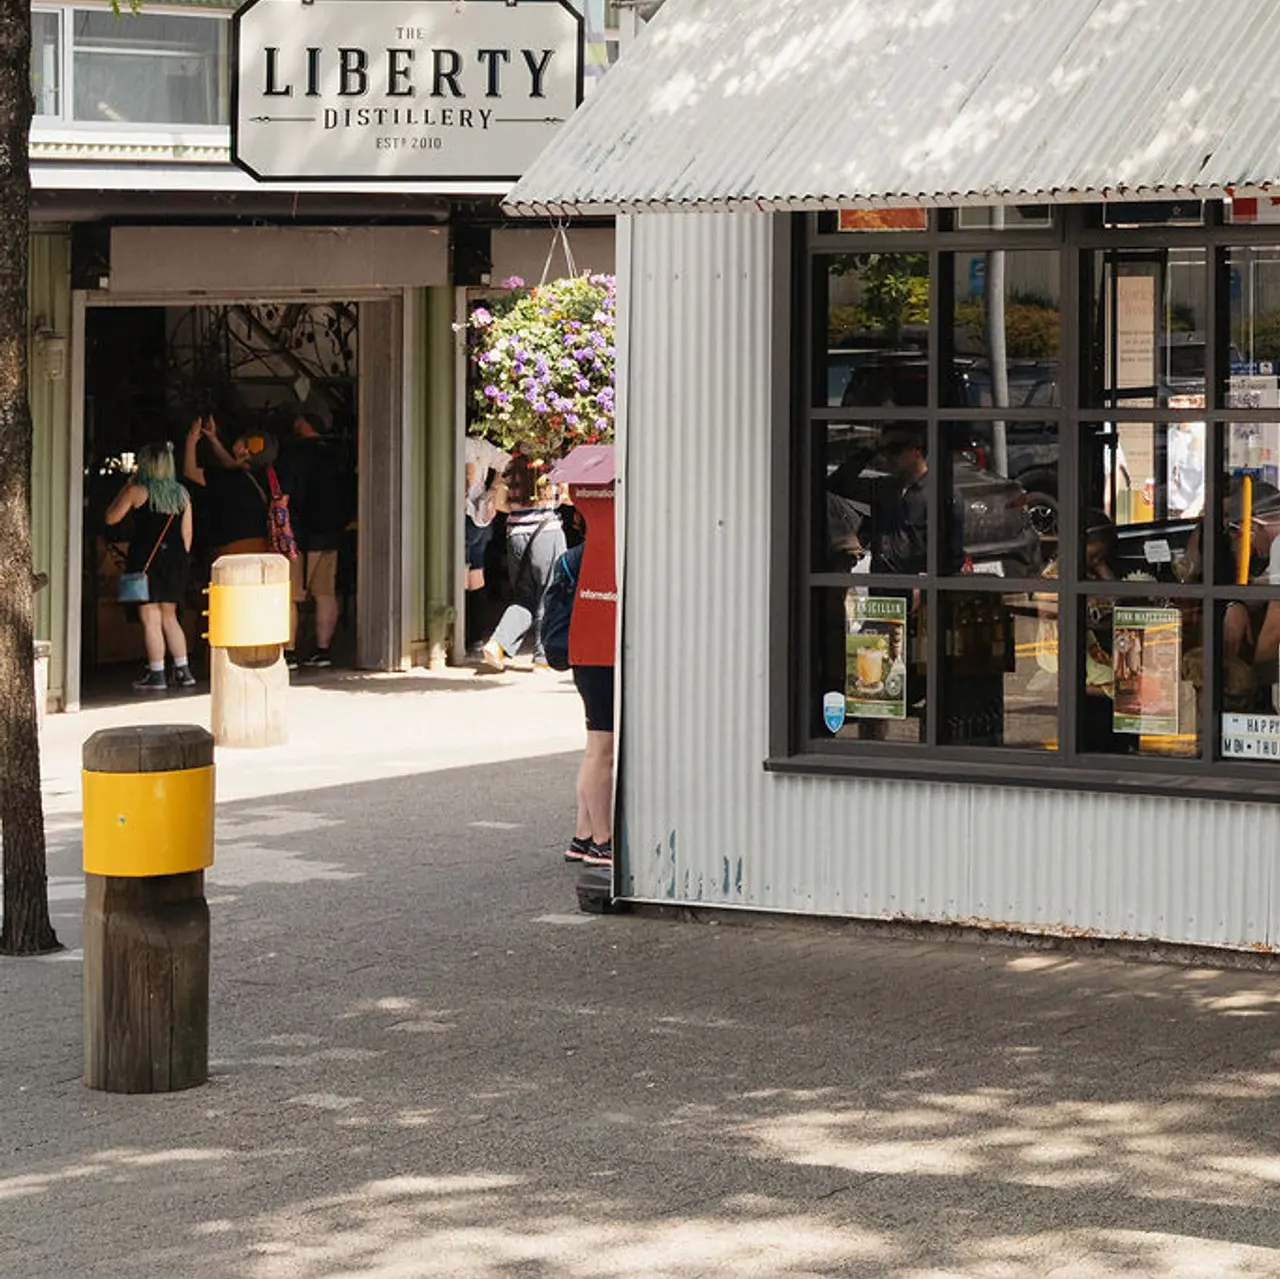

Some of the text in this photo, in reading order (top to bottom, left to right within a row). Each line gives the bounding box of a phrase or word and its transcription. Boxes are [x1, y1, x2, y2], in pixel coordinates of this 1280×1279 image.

[396, 26, 425, 40] THE
[263, 47, 555, 99] LIBERTY
[324, 108, 493, 130] DISTILLERY
[411, 137, 442, 150] 2010
